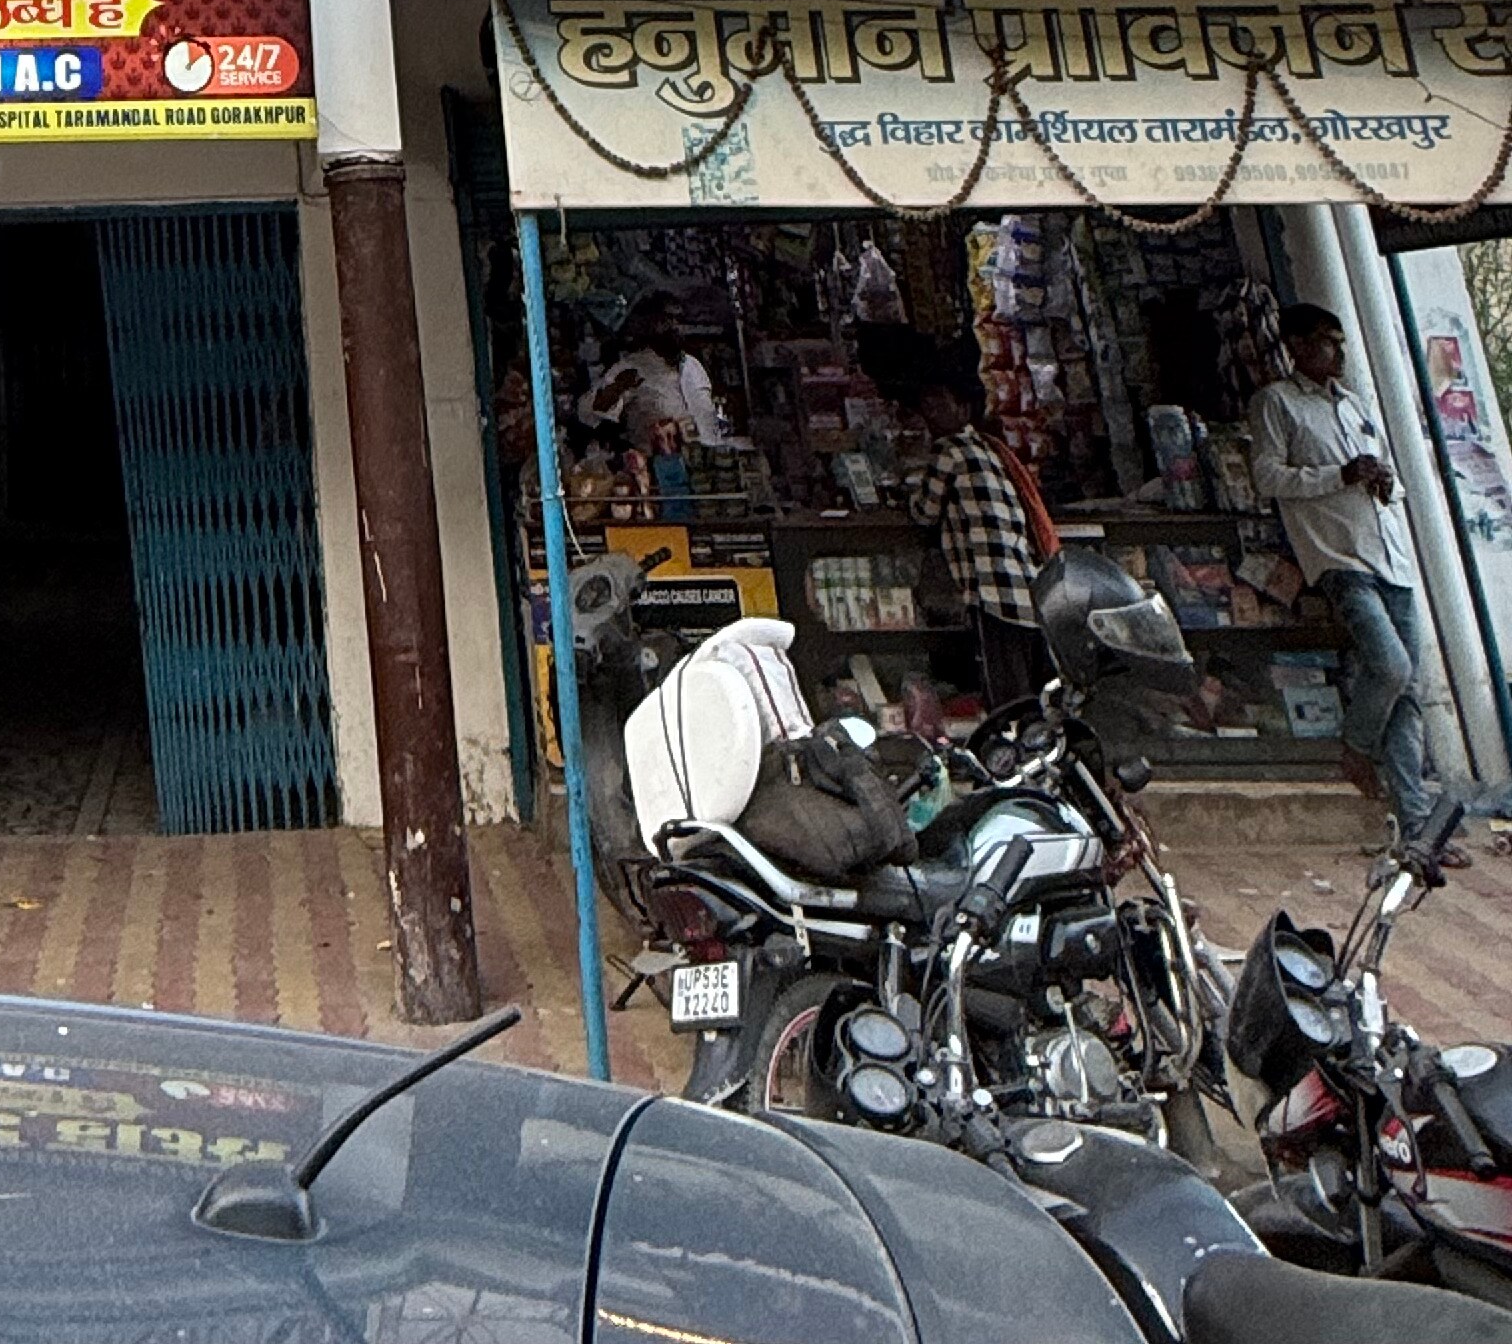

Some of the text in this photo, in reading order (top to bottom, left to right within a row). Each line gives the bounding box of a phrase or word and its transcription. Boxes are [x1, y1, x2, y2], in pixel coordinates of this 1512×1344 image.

[14, 52, 82, 92] A.C
[217, 43, 281, 72] 24/7
[218, 71, 282, 86] SERVICE
[55, 108, 161, 129] TARAMANDAL
[165, 107, 206, 127] ROAD
[211, 105, 306, 126] GORAKHPUR
[878, 112, 965, 146] विहार
[1307, 108, 1452, 150] गोरखपुर
